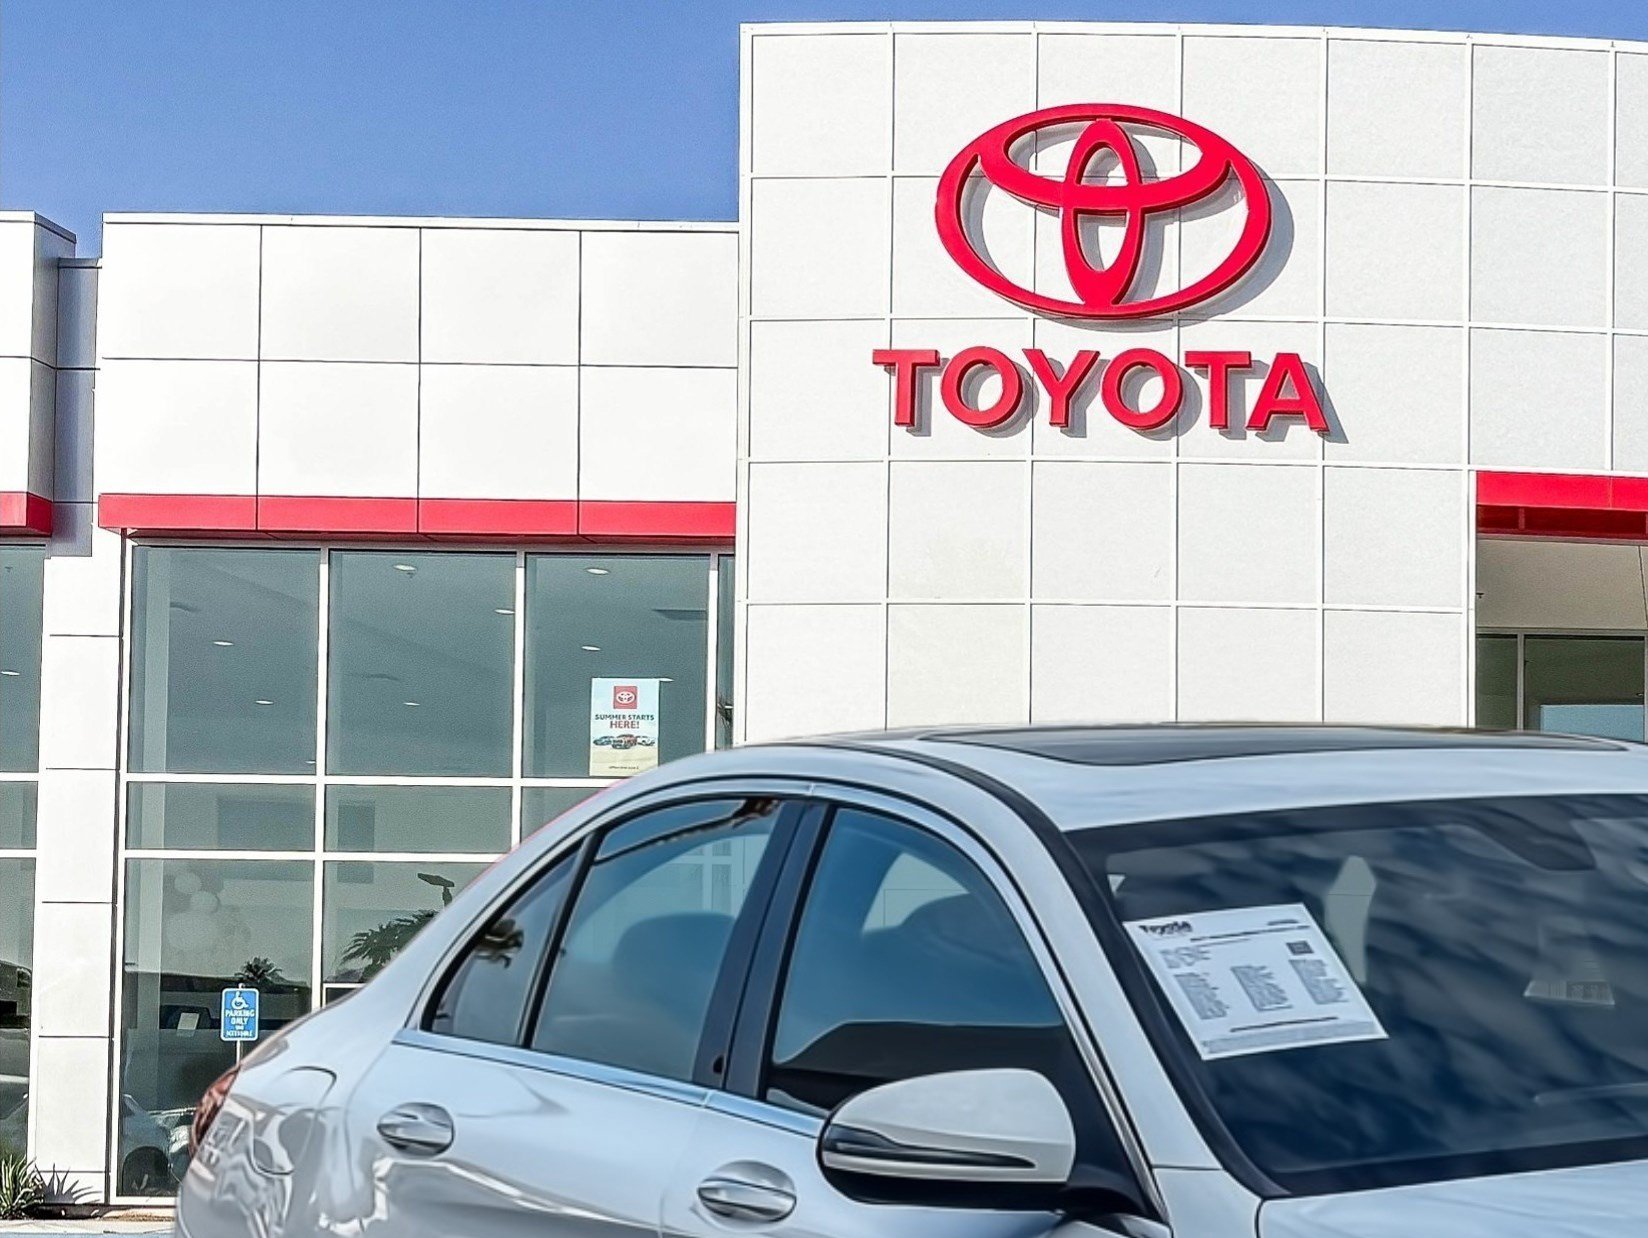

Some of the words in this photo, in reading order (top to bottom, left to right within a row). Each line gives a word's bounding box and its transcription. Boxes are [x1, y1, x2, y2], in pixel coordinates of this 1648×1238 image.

[872, 346, 1330, 433] TOYOTA
[609, 720, 640, 729] HERE!
[225, 1009, 255, 1017] PARKING
[230, 1017, 249, 1025] ONLY
